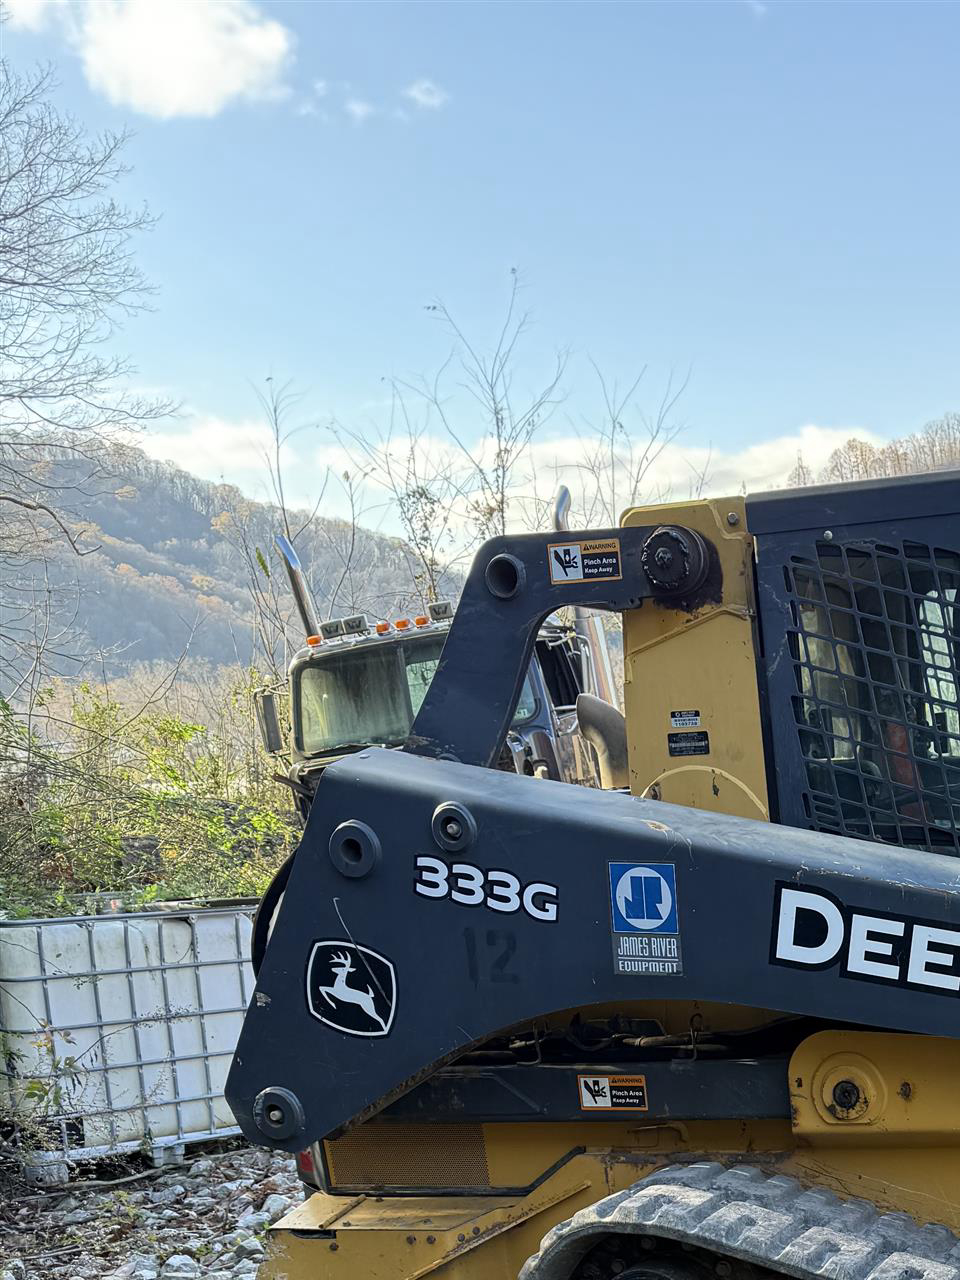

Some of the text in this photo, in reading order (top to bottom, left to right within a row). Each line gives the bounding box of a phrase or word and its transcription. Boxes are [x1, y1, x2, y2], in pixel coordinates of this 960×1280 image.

[589, 542, 617, 550] WARNING
[583, 557, 617, 566] Pinch Area
[414, 855, 558, 922] 333G
[618, 936, 679, 957] JAMES RIVER
[618, 960, 679, 973] EQUIPMENT
